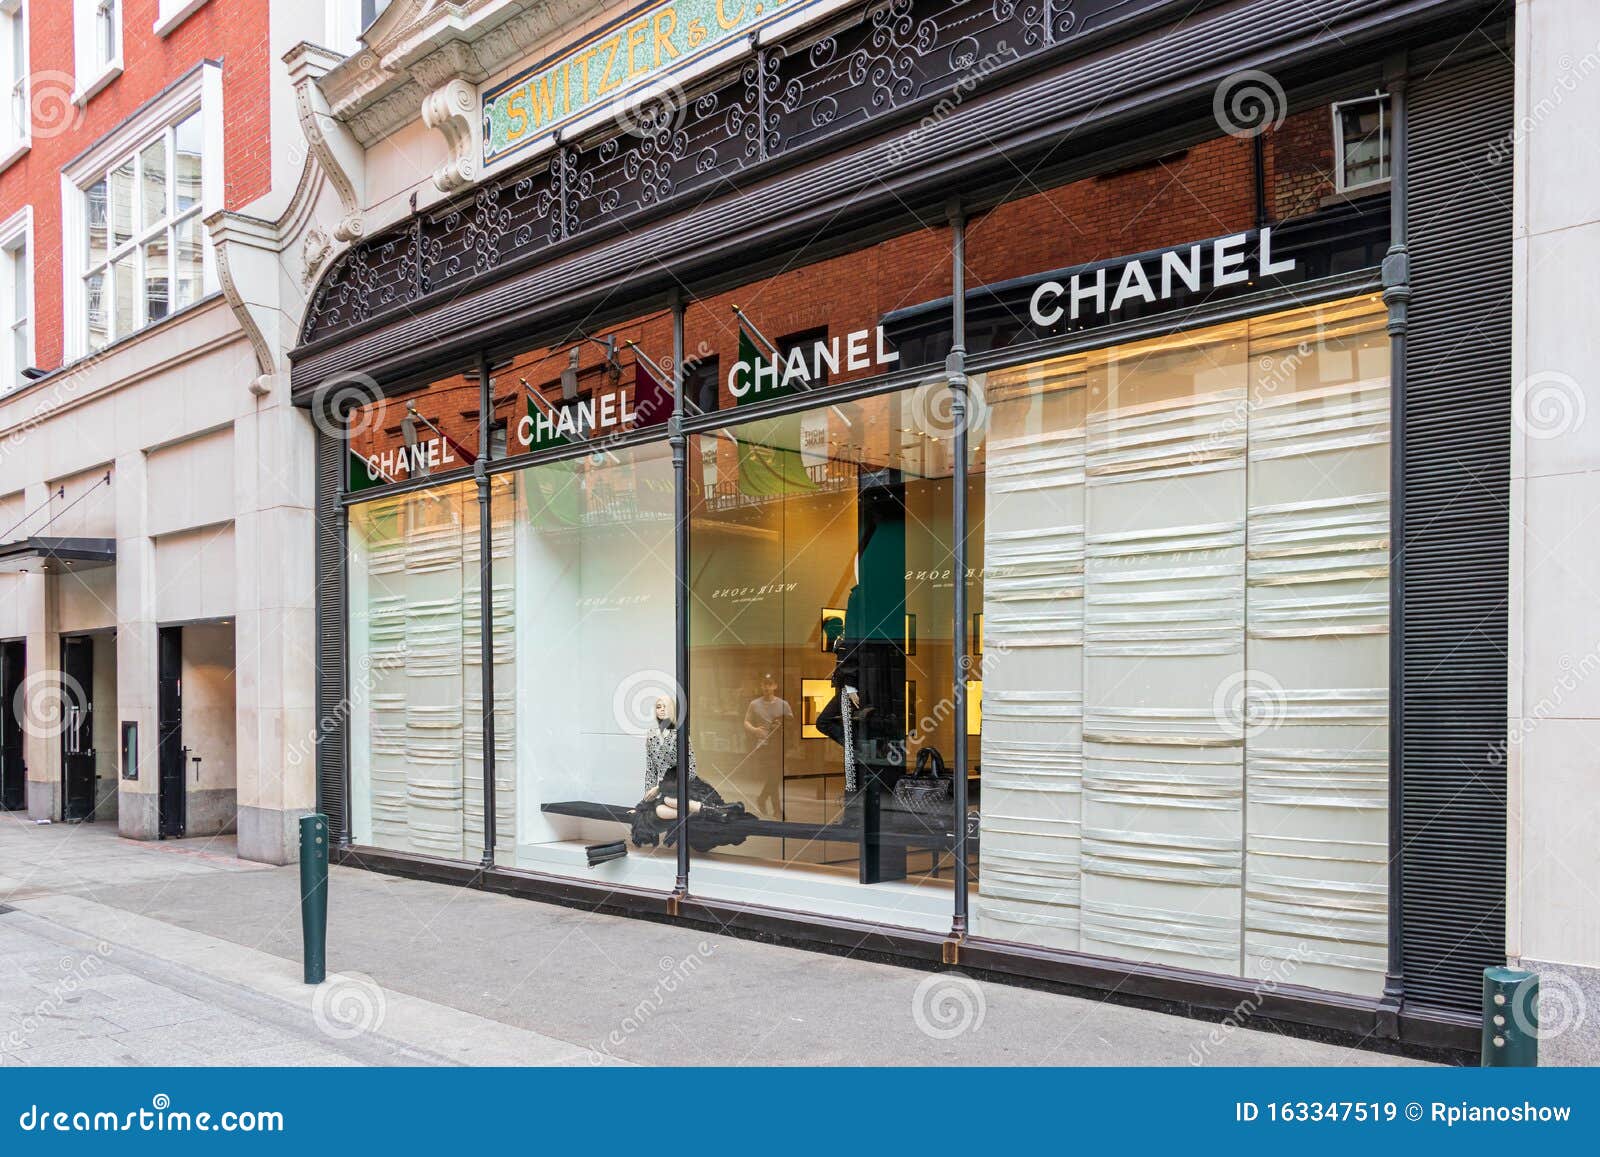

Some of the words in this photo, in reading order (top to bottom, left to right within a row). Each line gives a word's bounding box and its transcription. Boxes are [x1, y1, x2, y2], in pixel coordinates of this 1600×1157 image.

[506, 7, 681, 141] SWITZER
[1029, 227, 1296, 327] CHANEL
[728, 326, 899, 397] CHANEL
[517, 390, 637, 446] CHANEL
[367, 436, 455, 481] CHANEL
